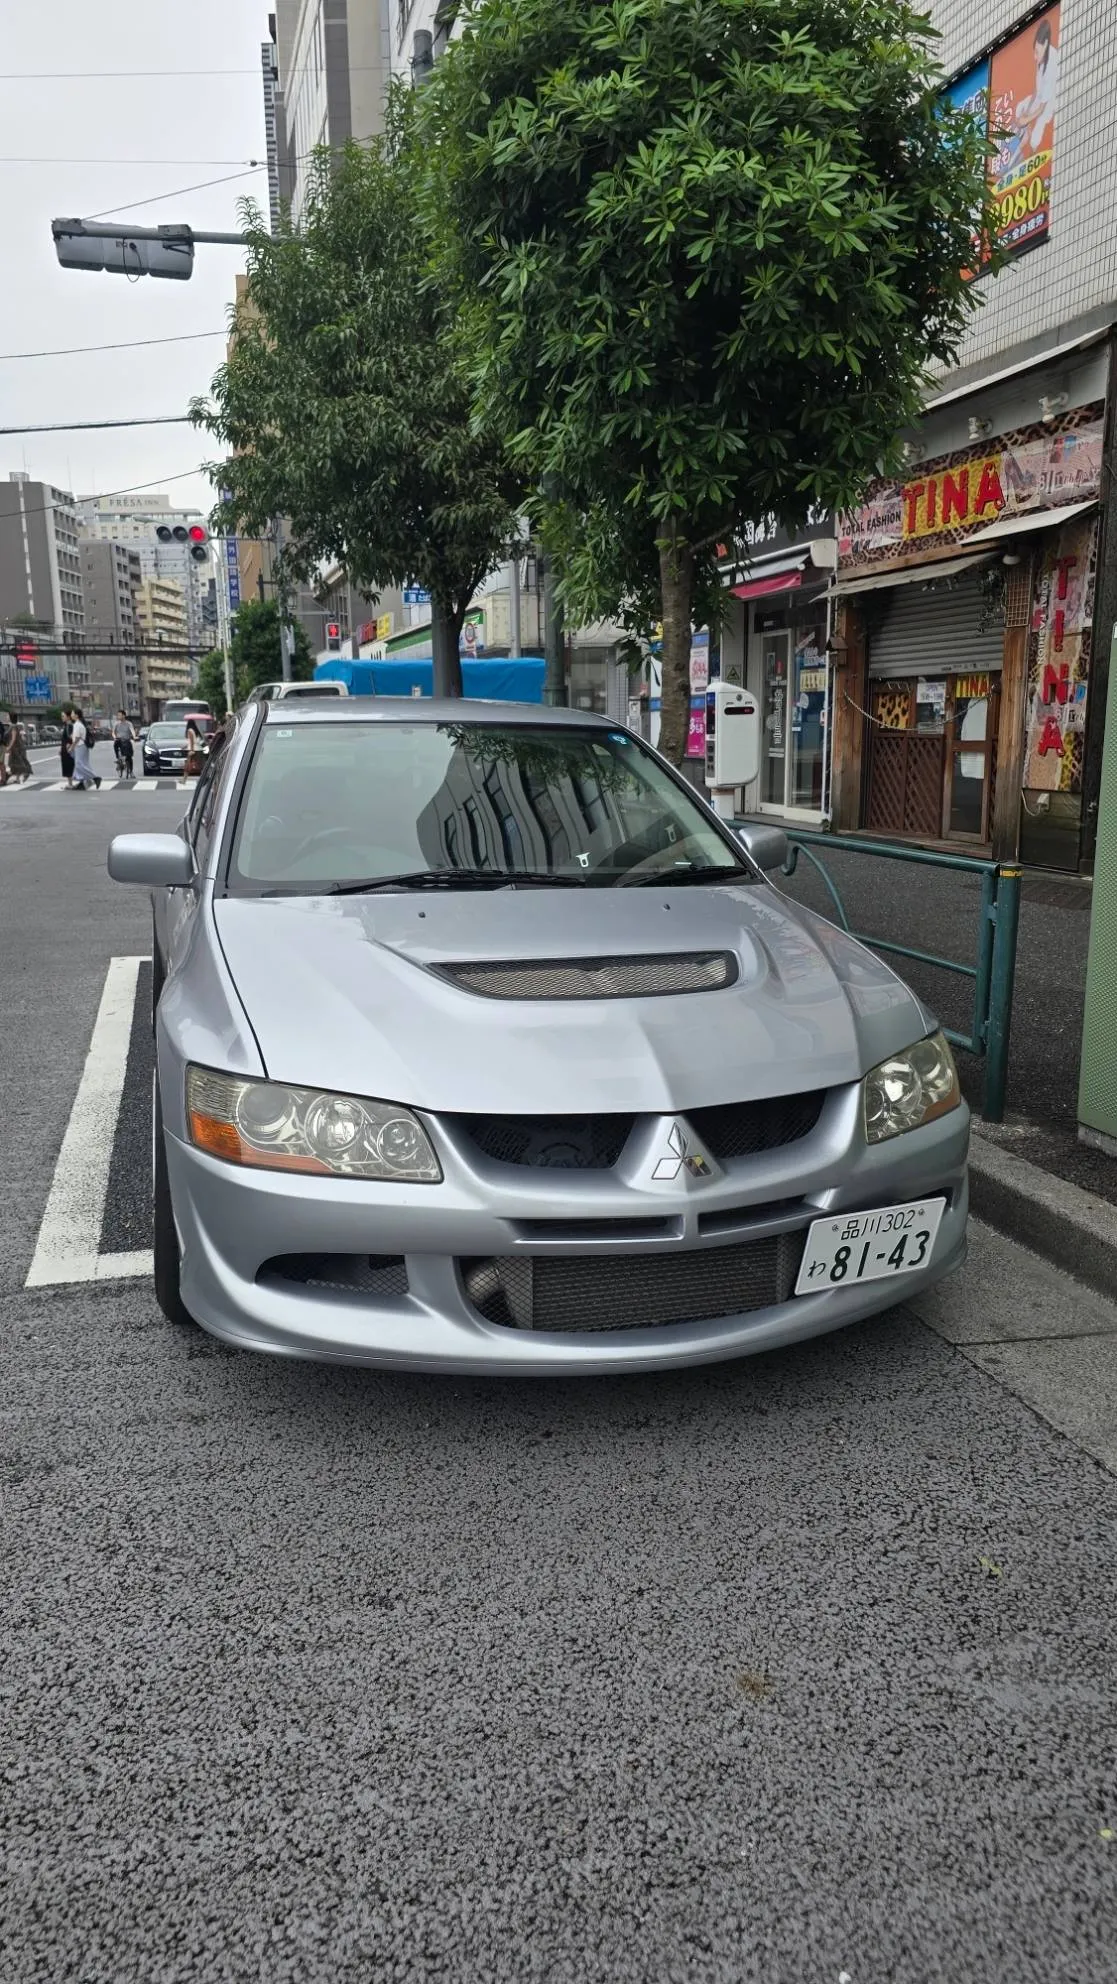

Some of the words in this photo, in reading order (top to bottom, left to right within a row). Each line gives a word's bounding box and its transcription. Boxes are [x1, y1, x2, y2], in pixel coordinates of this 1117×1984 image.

[842, 522, 865, 536] TOTAL
[867, 512, 901, 530] FASHION
[902, 462, 1006, 534] TINA
[1038, 556, 1077, 757] TINA
[841, 1210, 916, 1240] 品川302
[808, 1260, 826, 1278] わ
[830, 1230, 930, 1282] 81-43
